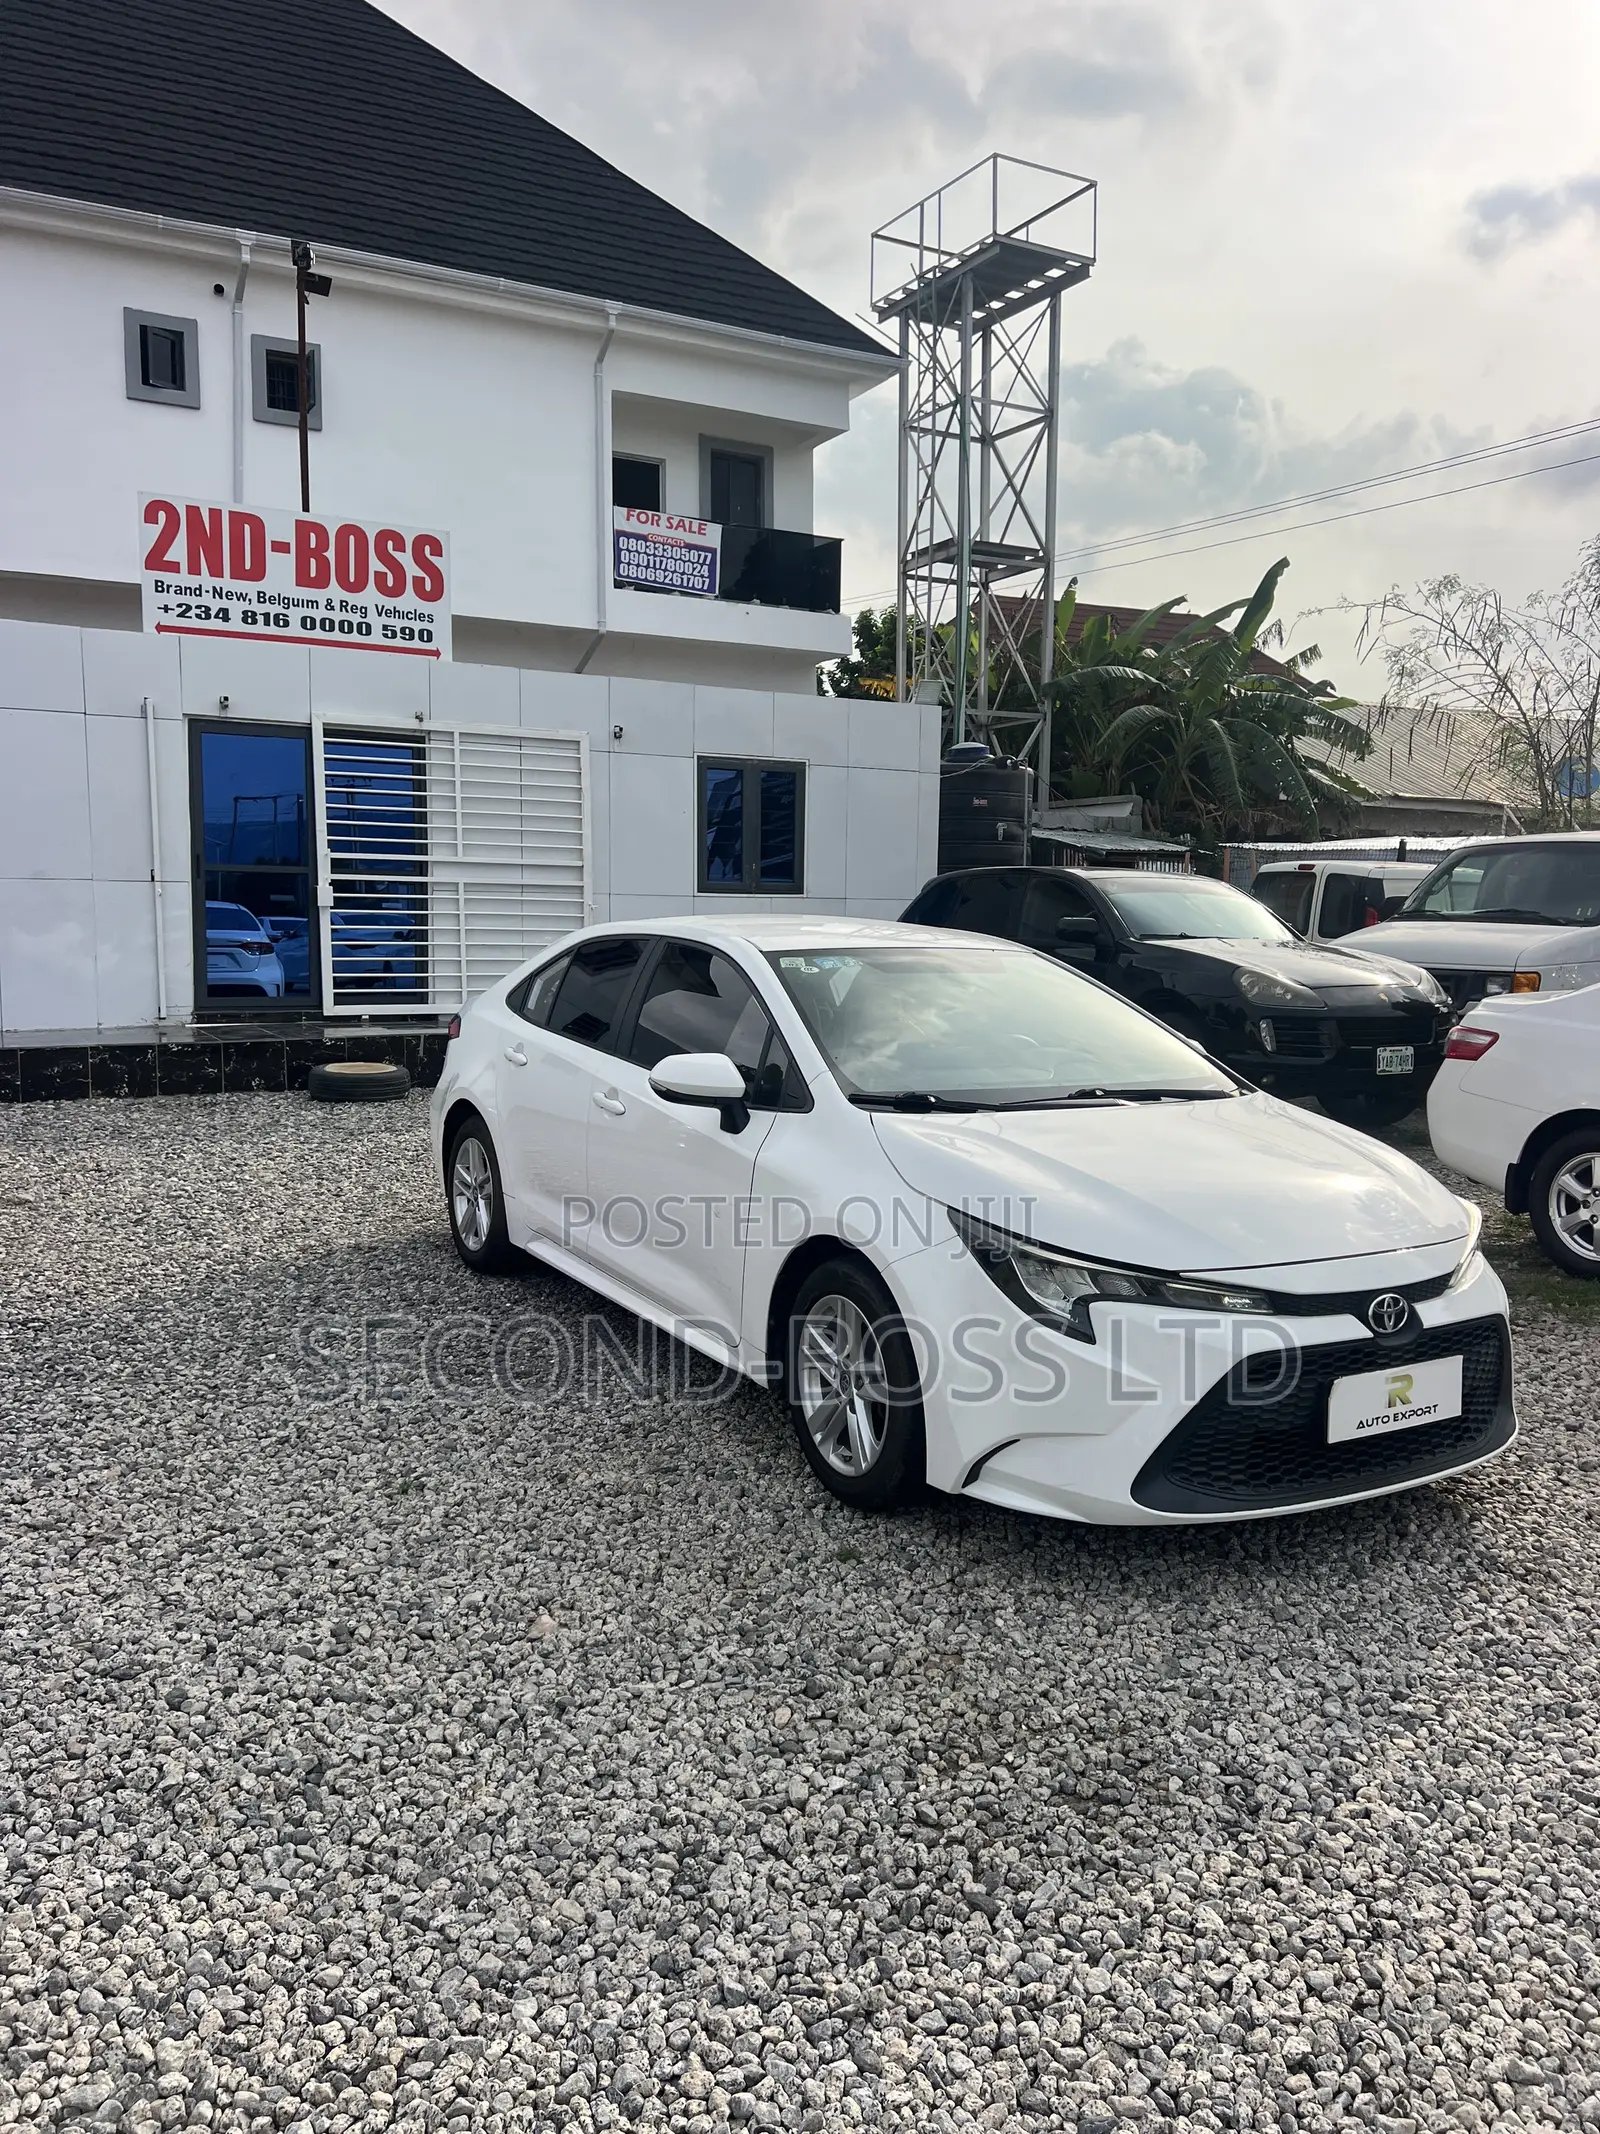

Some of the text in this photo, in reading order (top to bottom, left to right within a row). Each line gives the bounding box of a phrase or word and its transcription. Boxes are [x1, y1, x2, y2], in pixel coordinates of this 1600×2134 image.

[625, 507, 708, 536] FOR SALE
[143, 499, 444, 602] 2ND-BOSS
[619, 536, 712, 565] 08033305077
[648, 534, 685, 547] CONTACTS
[619, 563, 710, 590] 08069261707
[620, 550, 709, 578] 09011780024
[154, 579, 252, 605] Brand-New,
[324, 597, 336, 612] &
[339, 599, 368, 619] Reg
[374, 603, 435, 624] Vehicles
[157, 602, 434, 644] +234 816 0000 590
[1355, 1403, 1440, 1431] AUTO EXPORT
